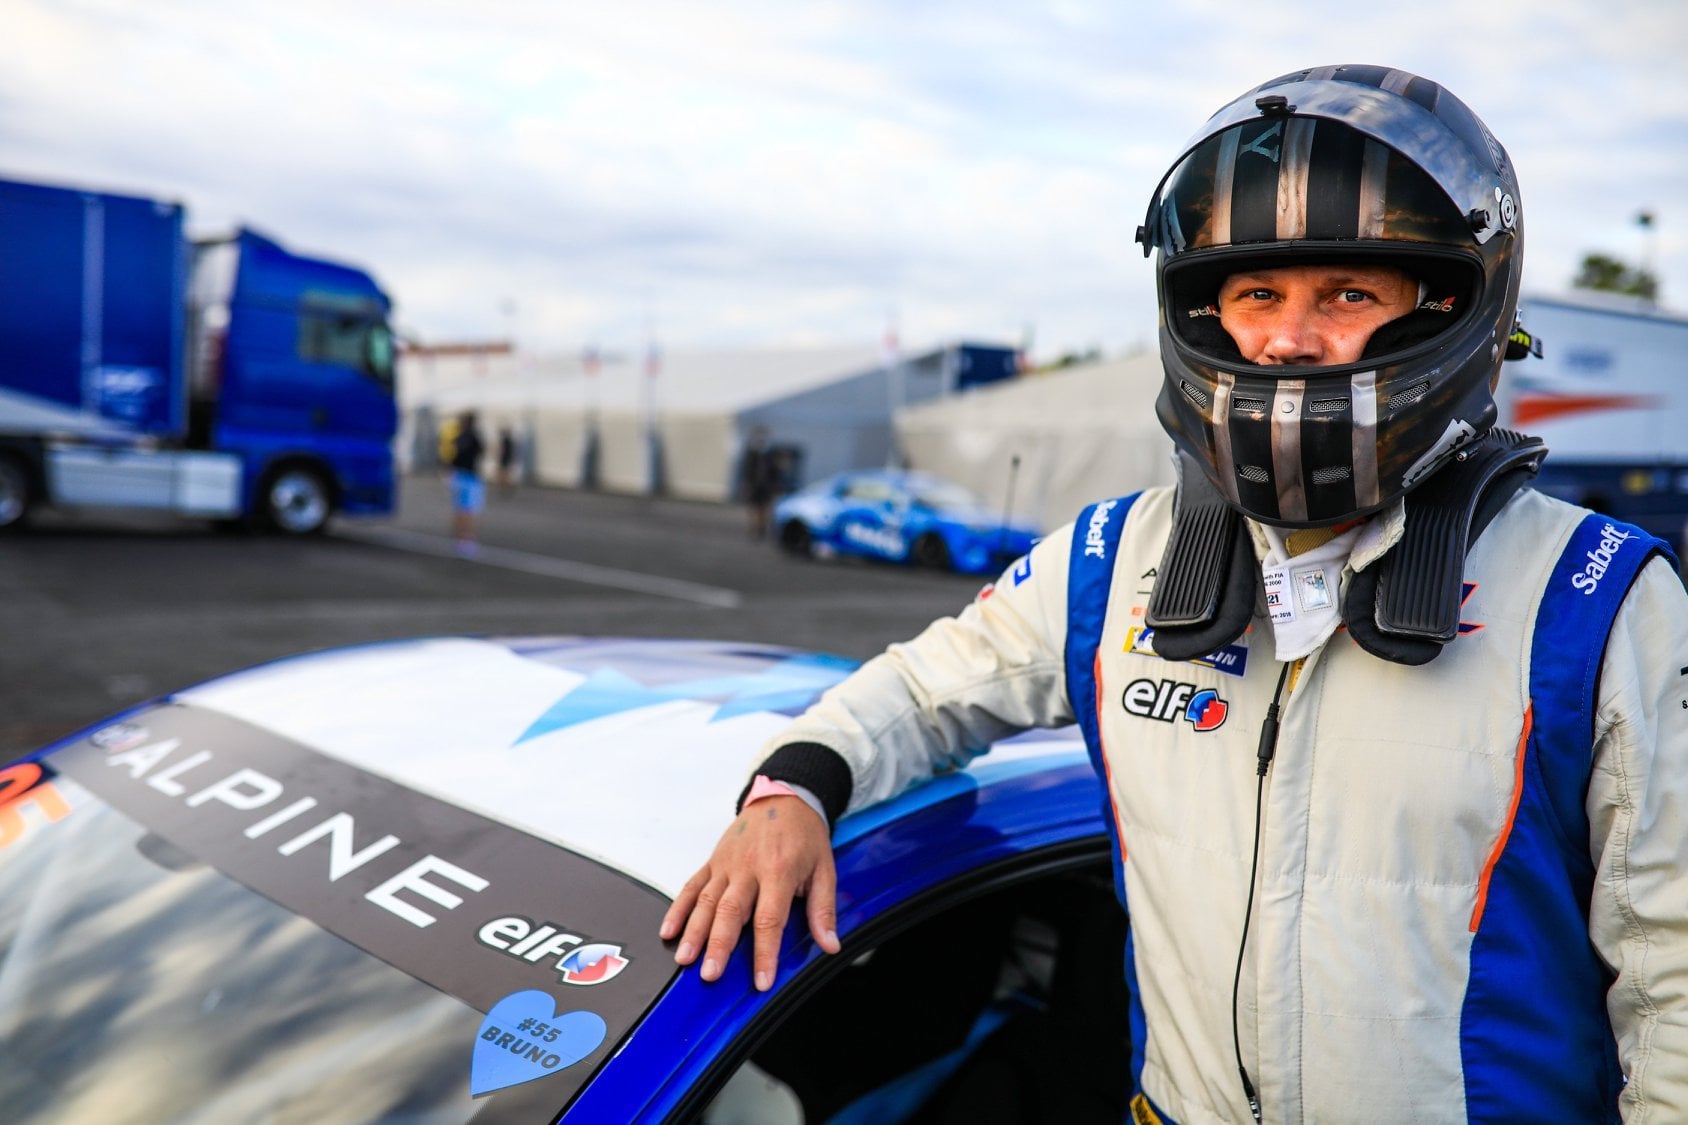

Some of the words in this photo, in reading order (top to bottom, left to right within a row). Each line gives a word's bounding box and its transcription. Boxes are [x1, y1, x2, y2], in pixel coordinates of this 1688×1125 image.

[1572, 523, 1632, 595] Sabelt
[1123, 679, 1194, 722] elf
[107, 737, 490, 929] ALPINE
[478, 917, 584, 963] elf
[481, 1025, 561, 1069] BRUNO
[516, 1017, 563, 1043] #55
